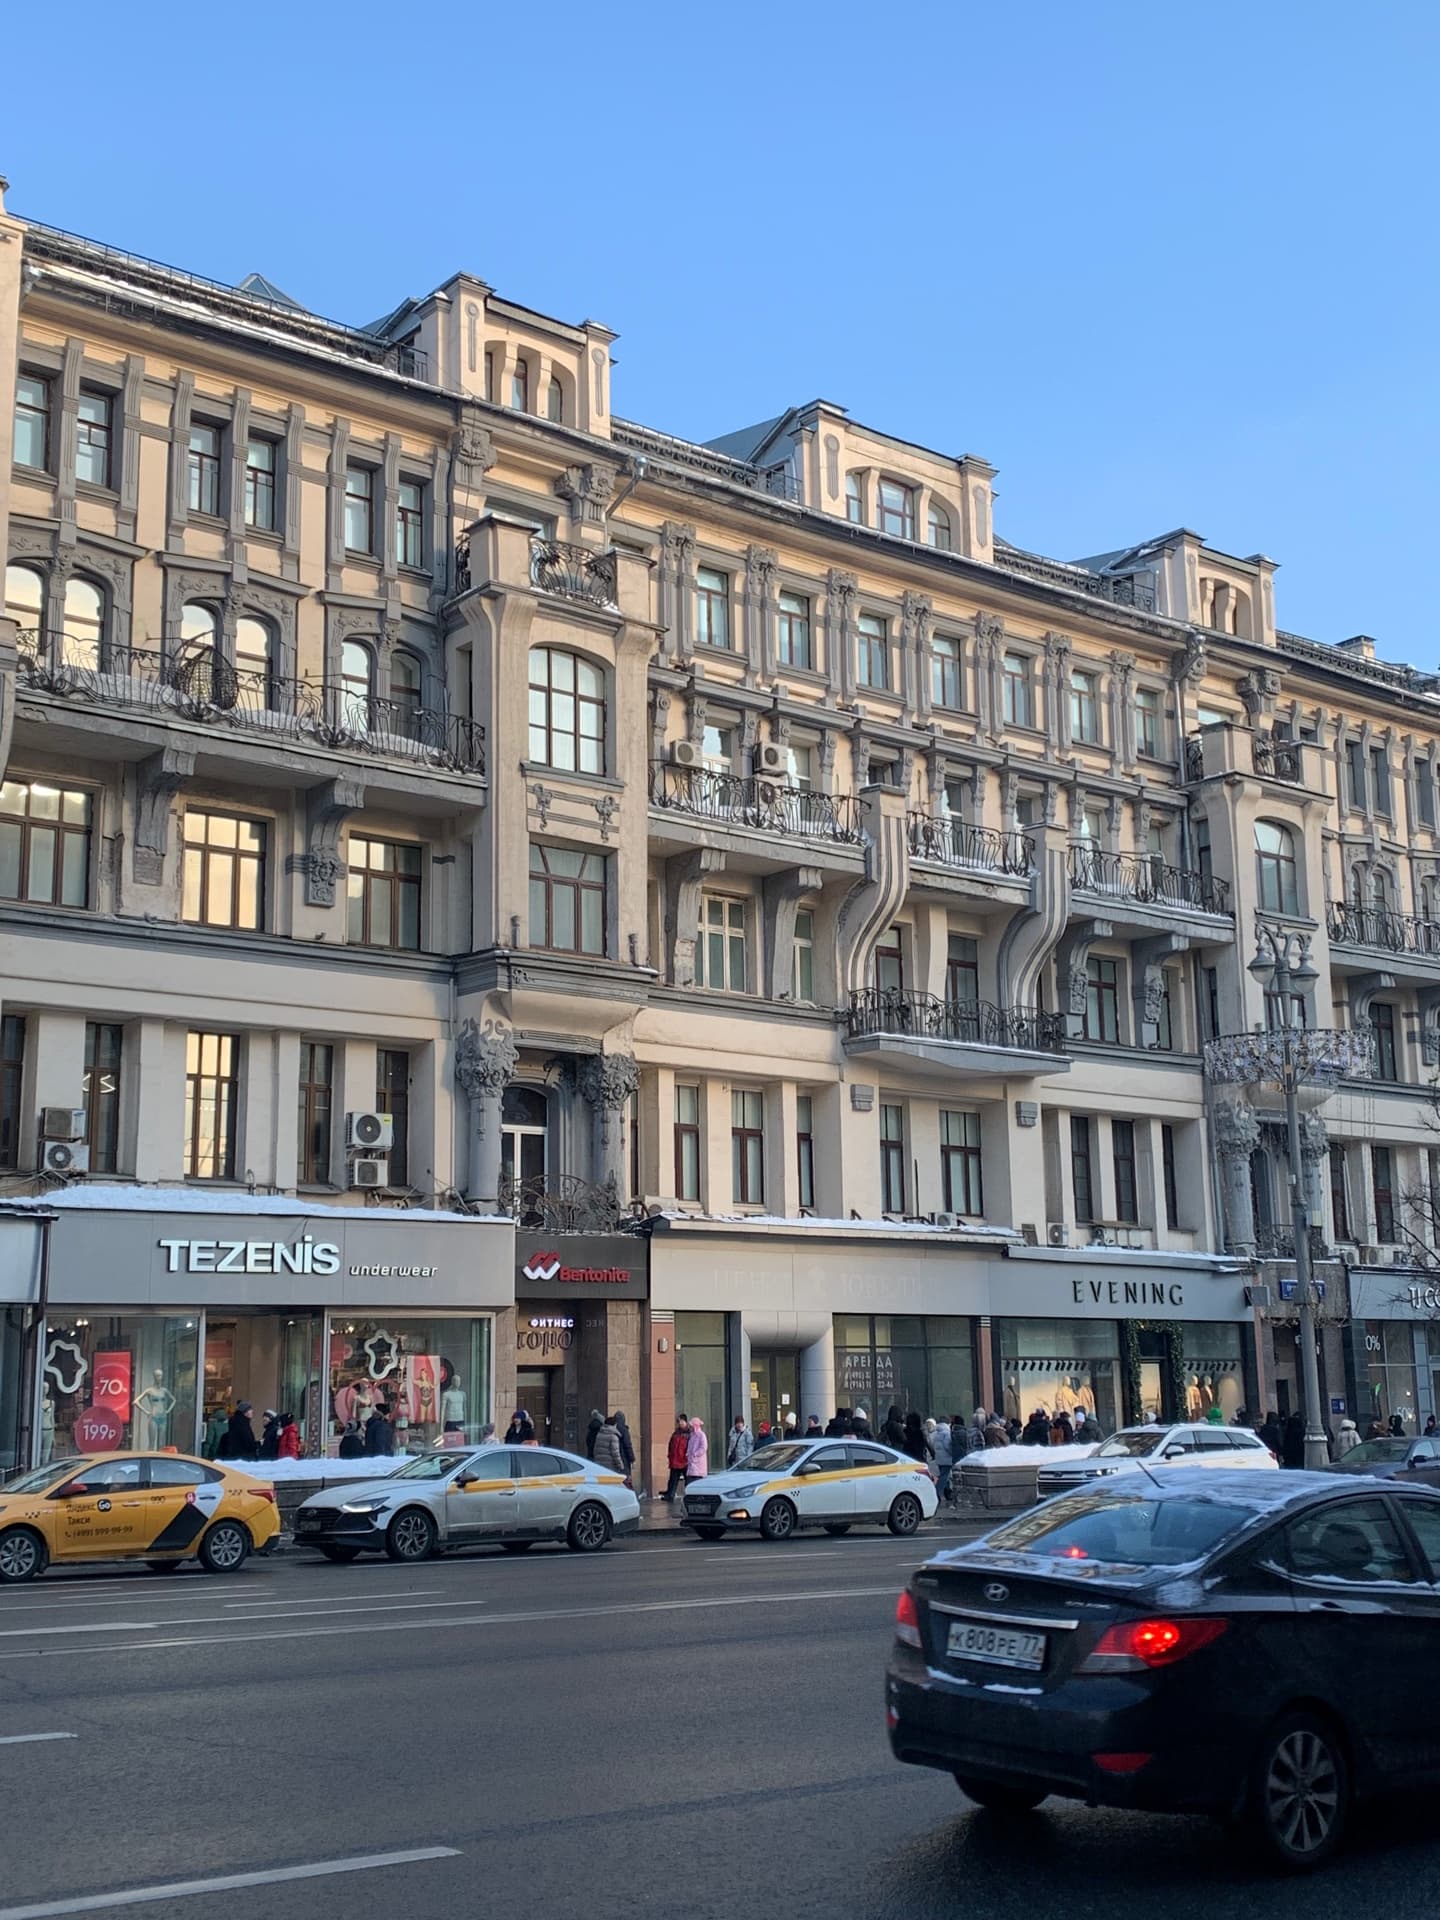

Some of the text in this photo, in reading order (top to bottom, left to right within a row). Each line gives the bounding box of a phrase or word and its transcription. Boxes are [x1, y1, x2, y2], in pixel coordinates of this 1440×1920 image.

[350, 1264, 438, 1277] underwear
[559, 1267, 631, 1283] Bentonite
[1072, 1280, 1183, 1306] EVENING
[1409, 1286, 1422, 1309] TJ
[530, 1318, 574, 1329] ФИТНЕС
[98, 1500, 111, 1510] Go
[68, 1516, 91, 1525] Такси
